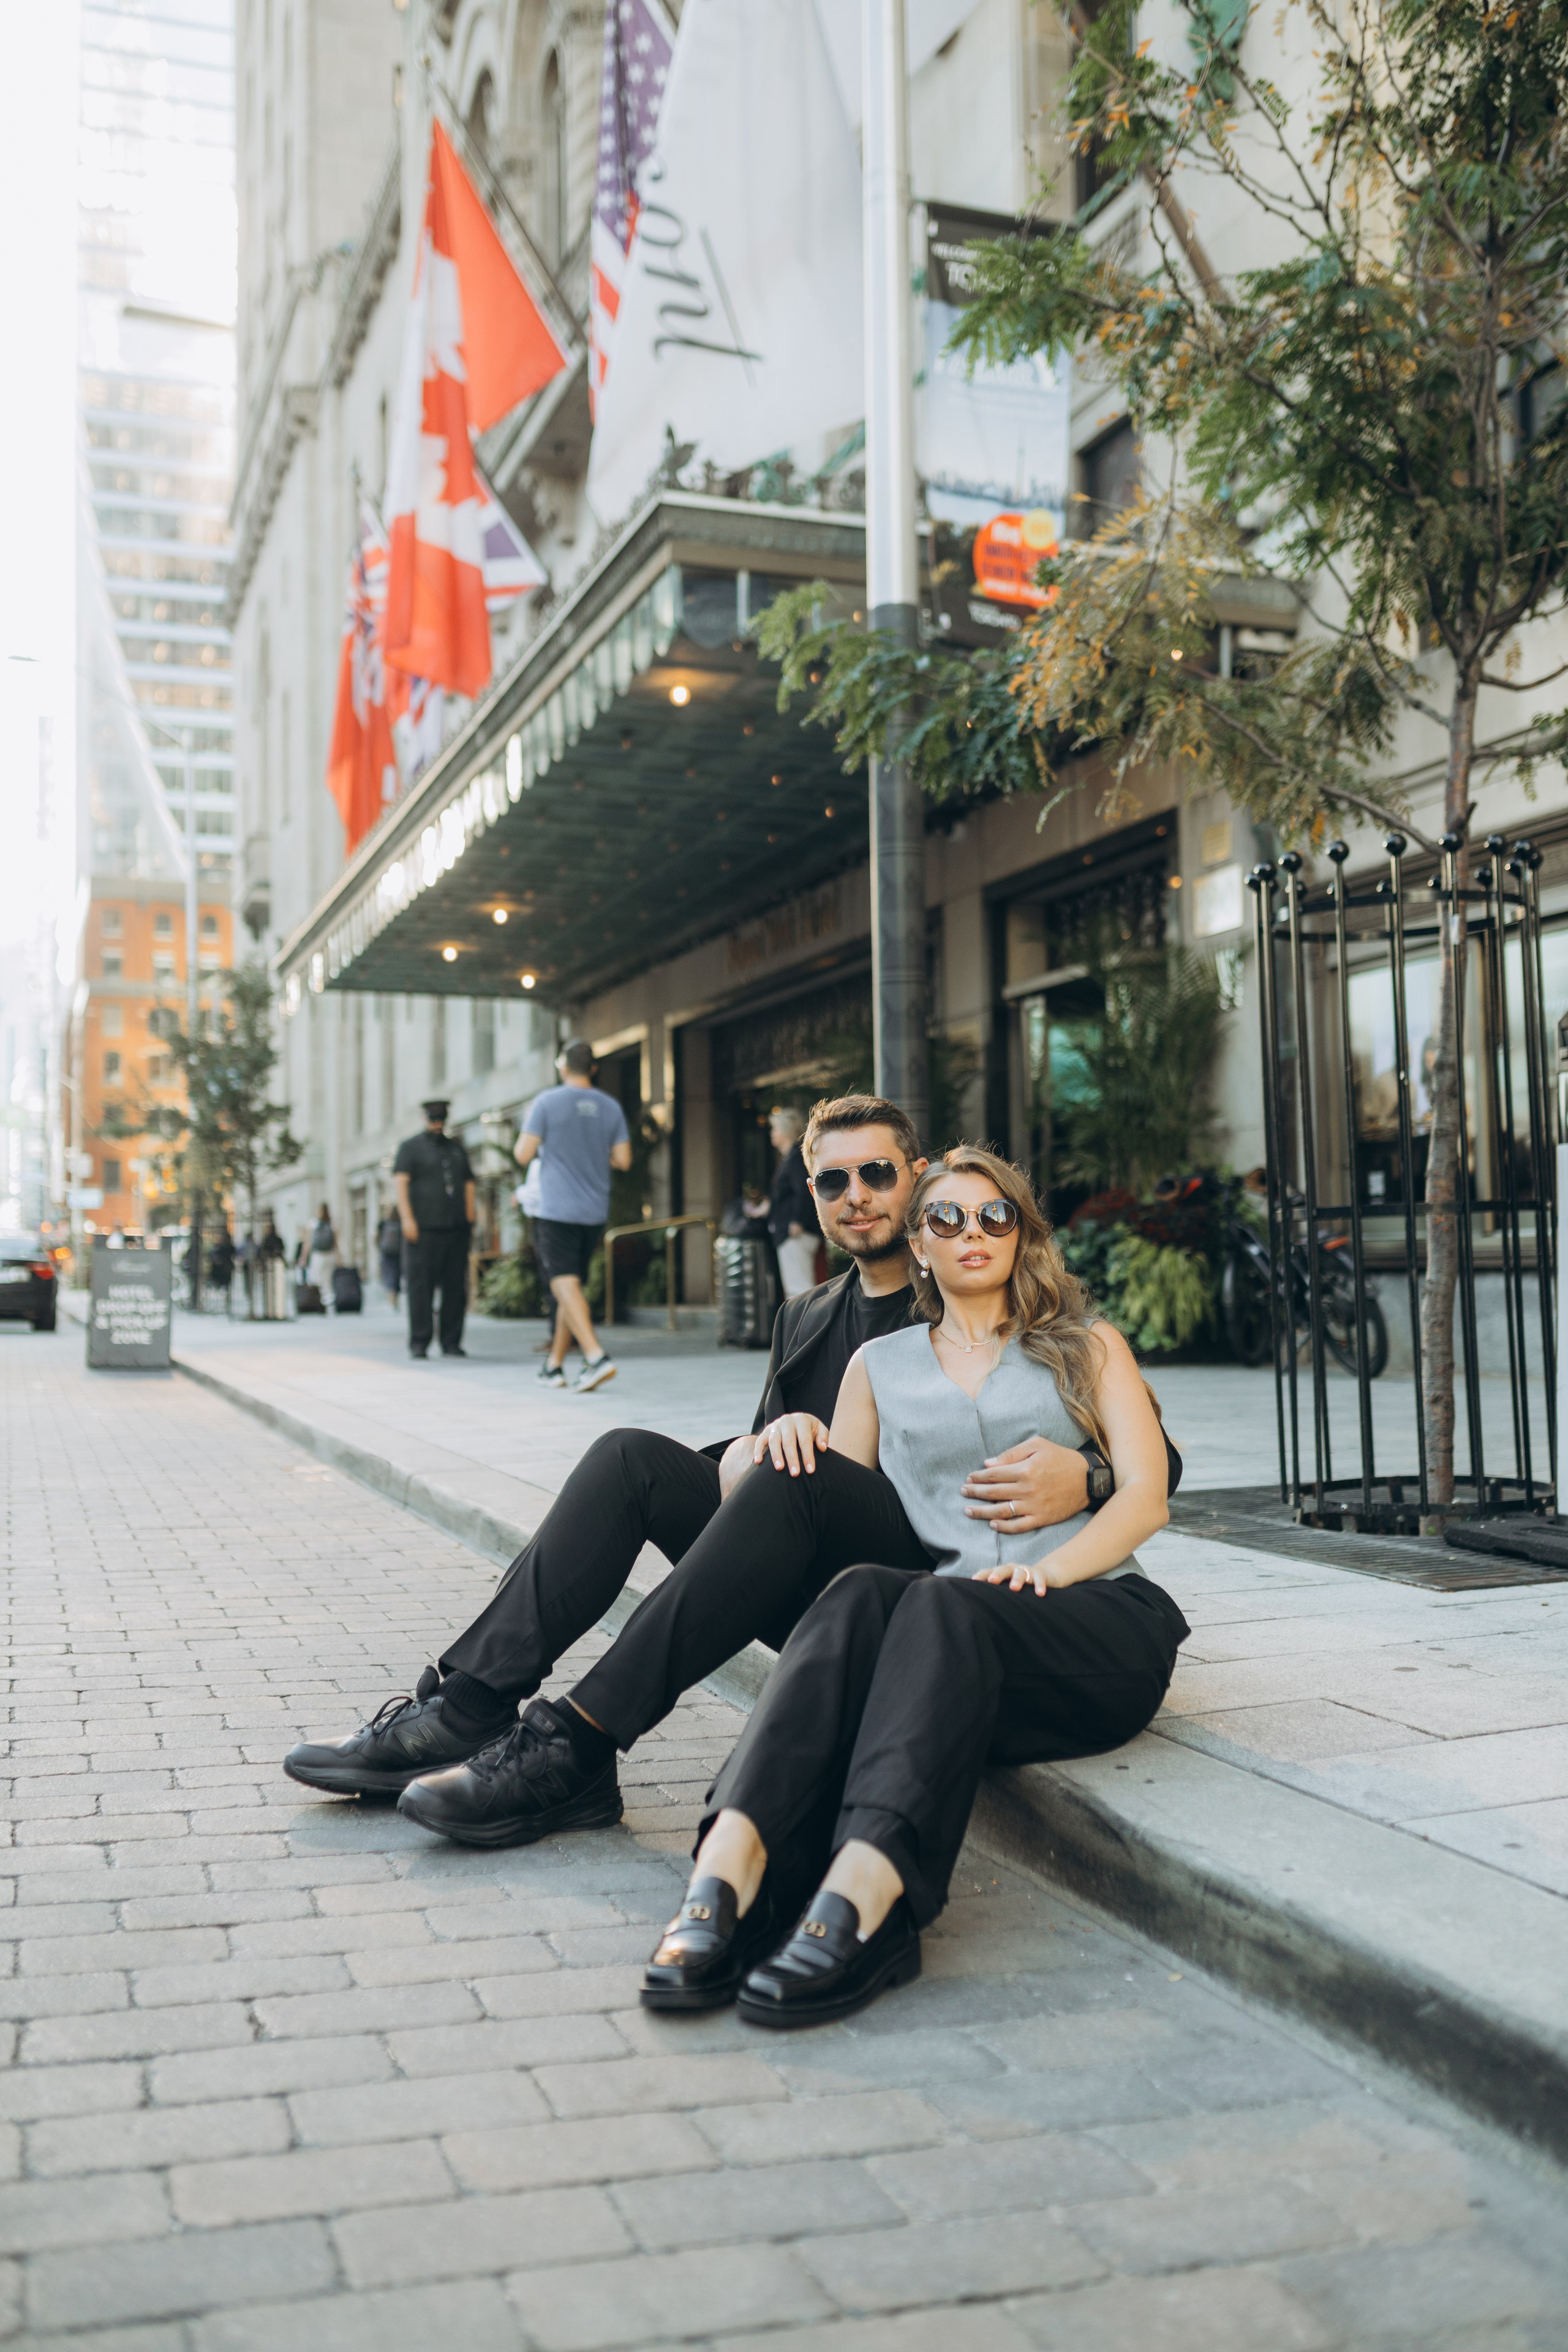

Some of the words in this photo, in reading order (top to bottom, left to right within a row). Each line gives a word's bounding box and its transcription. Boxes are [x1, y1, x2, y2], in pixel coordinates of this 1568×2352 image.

[108, 1284, 153, 1301] HOTEL
[111, 1330, 152, 1344] ZONE
[394, 1724, 445, 1761] N
